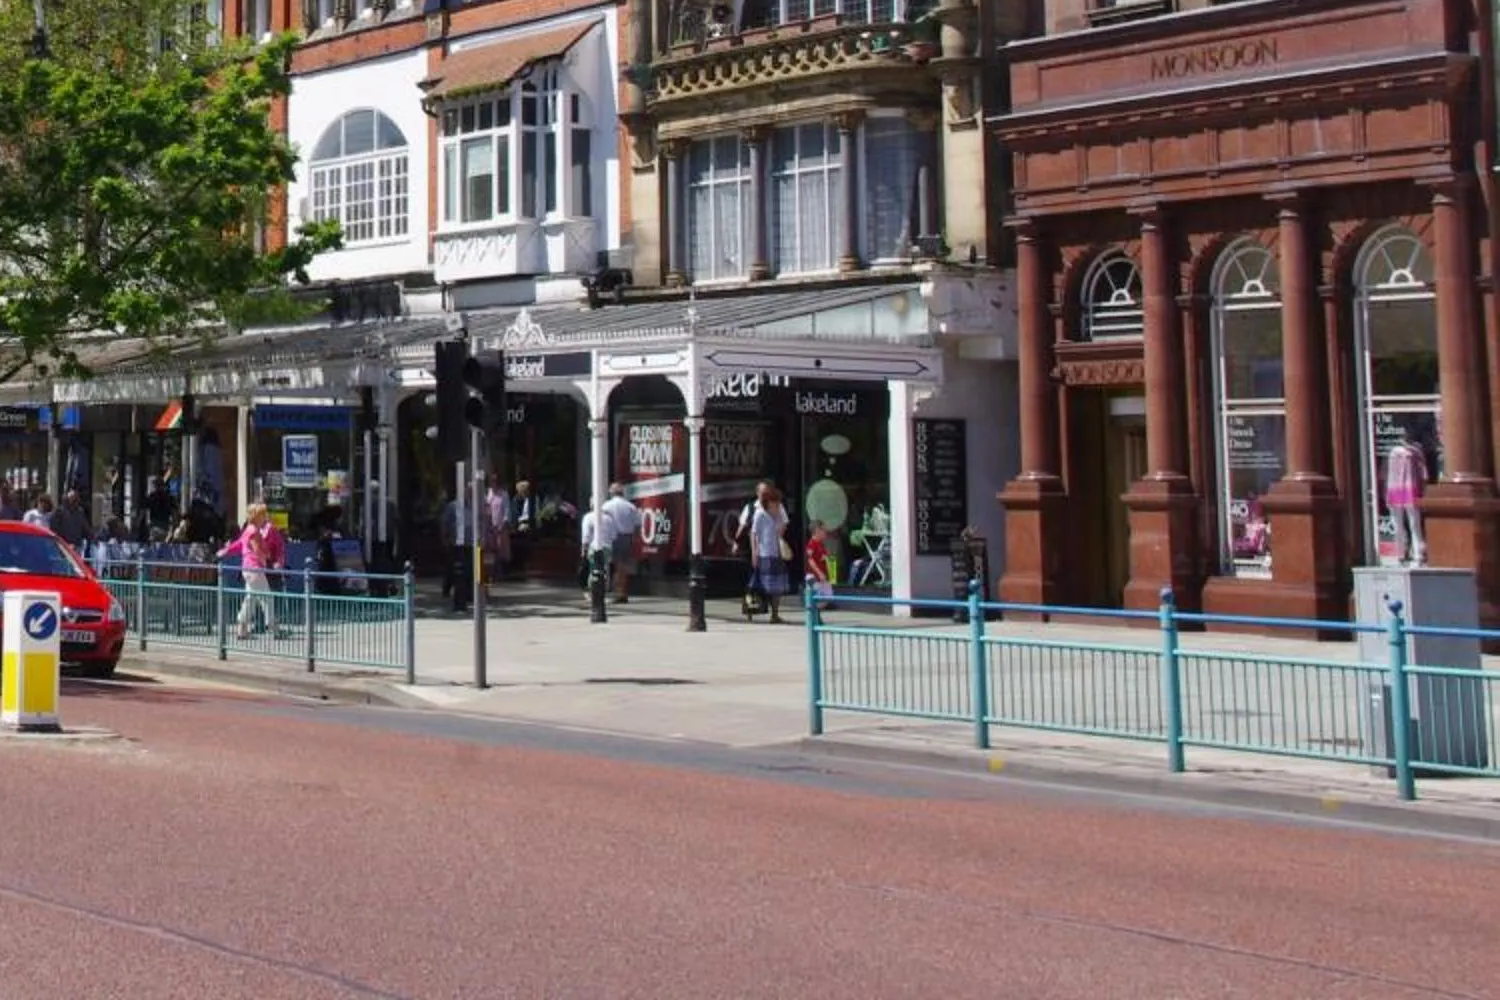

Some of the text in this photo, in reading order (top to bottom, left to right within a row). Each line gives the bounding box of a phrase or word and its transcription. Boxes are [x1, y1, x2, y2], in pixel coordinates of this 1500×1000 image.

[1151, 38, 1278, 79] MONSOON
[796, 392, 857, 414] lakeland
[629, 425, 673, 442] CLOSING
[629, 442, 673, 464] DOWN
[706, 443, 765, 465] DOWN
[640, 507, 671, 544] 0%
